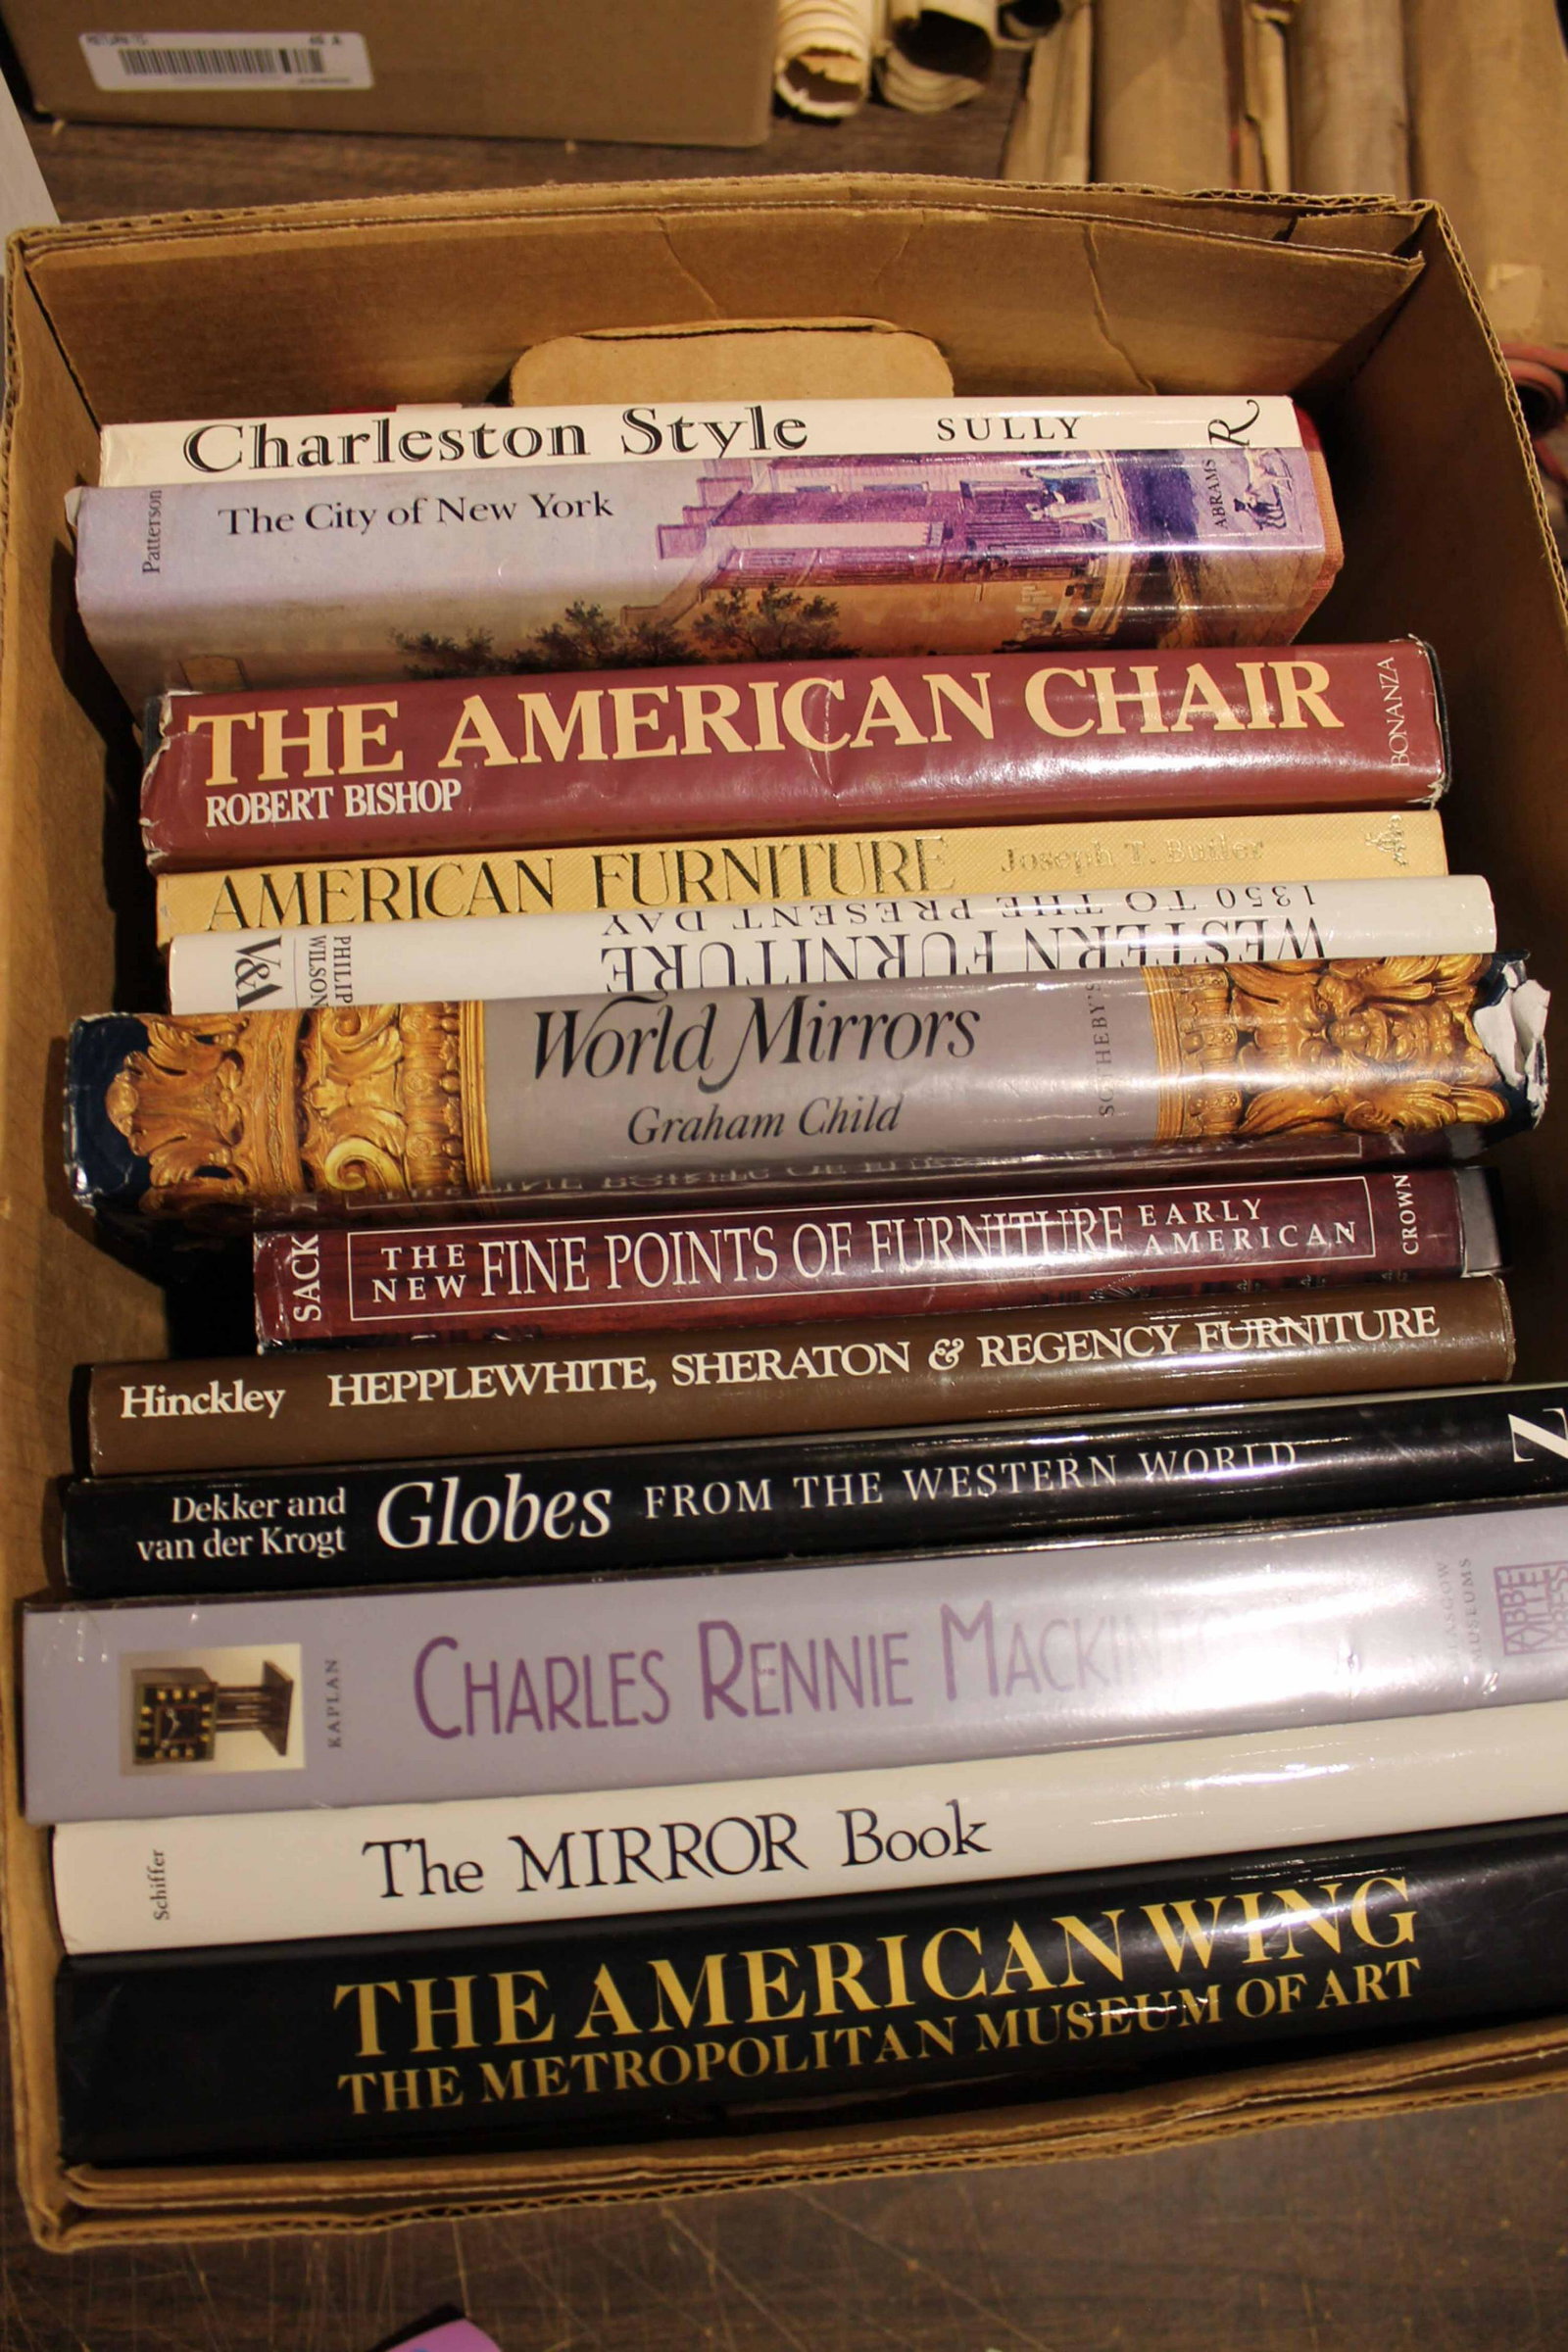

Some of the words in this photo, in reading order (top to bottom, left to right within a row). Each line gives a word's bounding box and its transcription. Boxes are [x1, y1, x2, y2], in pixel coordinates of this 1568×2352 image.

[183, 417, 590, 472] Charleston
[621, 404, 808, 458] Style
[937, 416, 1081, 442] SULLY
[218, 506, 294, 536] The
[306, 500, 377, 537] City
[387, 497, 426, 526] of
[436, 495, 517, 524] New
[529, 490, 614, 519] York
[1201, 458, 1229, 530] ABRAMS
[142, 490, 163, 575] Patterson
[187, 699, 405, 787] THE
[437, 671, 993, 770] AMERICAN
[1024, 661, 1345, 738] CHAIR
[1375, 656, 1411, 769] BONANZA
[205, 787, 333, 828] ROBERT
[344, 778, 463, 819] BISHOP
[206, 857, 555, 932] AMERICAN
[591, 835, 956, 909] FURNITURE
[1001, 841, 1115, 877] Joseph
[1166, 833, 1265, 864] Butler
[601, 909, 708, 937] DAY
[733, 897, 973, 930] PRESENT
[996, 893, 1104, 918] THE
[1124, 888, 1198, 912] TO
[1217, 884, 1317, 909] 1350
[233, 935, 283, 1011] V&A
[308, 934, 328, 1007] WILSON
[332, 935, 353, 1005] PHILIP
[601, 929, 999, 994] FURNITURE
[1025, 916, 1326, 973] WESTERN
[534, 992, 718, 1080] World
[697, 994, 982, 1094] Mirrors
[627, 1104, 785, 1146] Graham
[798, 1095, 906, 1137] Child
[1139, 1198, 1262, 1228] EARLY
[1144, 1221, 1358, 1257] AMERICAN
[1392, 1173, 1420, 1255] CROWN
[290, 1233, 321, 1323] SACK
[380, 1243, 466, 1271] THE
[478, 1236, 590, 1297] FINE
[604, 1225, 779, 1290] POINTS
[792, 1221, 854, 1279] OF
[869, 1205, 1125, 1275] FURNITURE
[372, 1274, 466, 1303] NEW
[326, 1356, 658, 1407] HEPPLEWHITE,
[671, 1340, 911, 1387] SHERATON
[927, 1338, 966, 1371] &
[977, 1323, 1180, 1367] REGENCY
[1195, 1305, 1442, 1352] FURNITURE
[120, 1379, 286, 1419] Hinckley
[172, 1491, 275, 1523] Dekker
[287, 1486, 347, 1516] and
[376, 1473, 612, 1549] Globes
[645, 1478, 773, 1520] FROM
[793, 1472, 884, 1509] THE
[903, 1453, 1118, 1501] WESTERN
[1138, 1442, 1298, 1484] WORLD
[136, 1537, 196, 1562] van
[203, 1528, 254, 1559] der
[260, 1526, 347, 1558] Krogt
[326, 1657, 343, 1750] KAPLAN
[413, 1635, 671, 1740] CHARLES
[698, 1620, 914, 1721] RENNIE
[362, 1838, 485, 1898] The
[508, 1811, 809, 1892] MIRROR
[835, 1799, 992, 1868] Book
[146, 1848, 171, 1921] Schiffer
[332, 1968, 557, 2058] THE
[574, 1908, 1126, 2039] AMERICAN
[1140, 1876, 1418, 1974] WING
[336, 2065, 465, 2115] THE
[479, 2016, 958, 2103] METROPOLITAN
[975, 1984, 1222, 2053] MUSEUM
[1236, 1972, 1309, 2019] OF
[1317, 1956, 1422, 2010] ART
